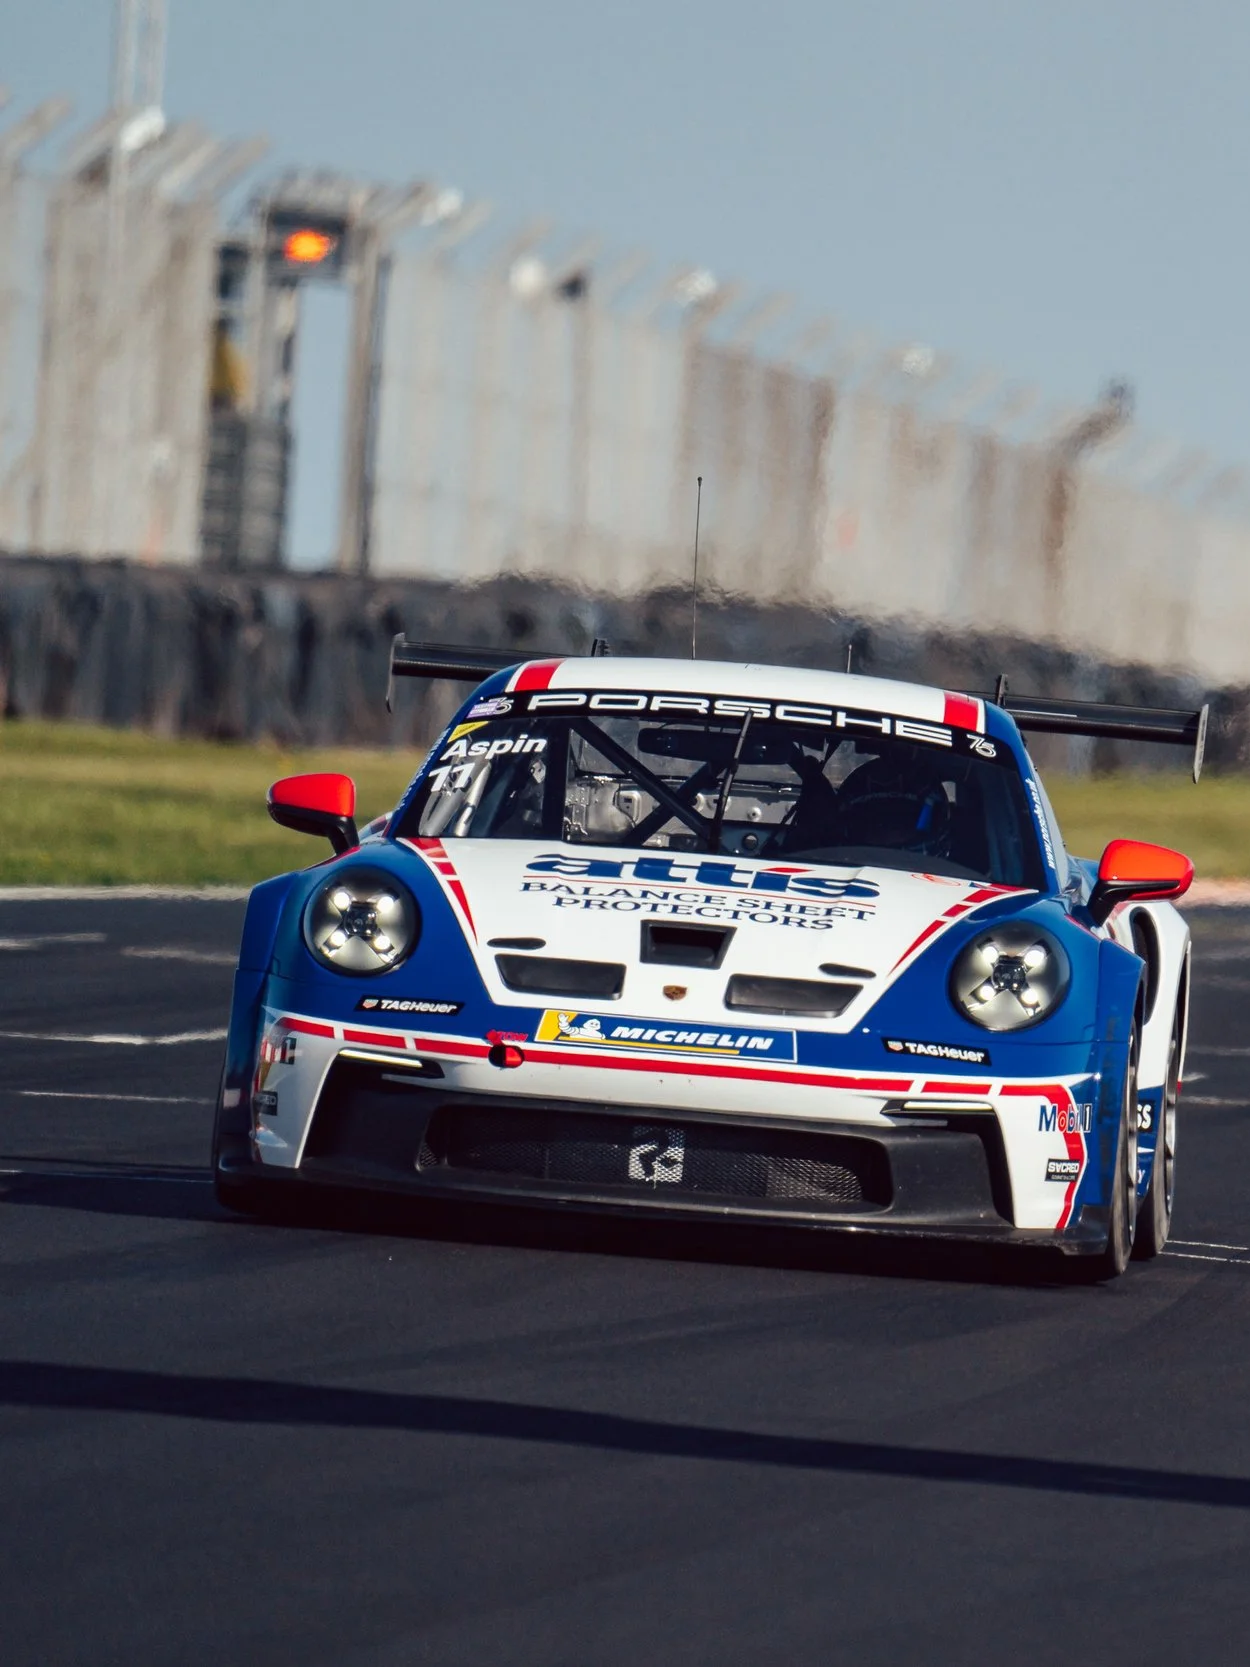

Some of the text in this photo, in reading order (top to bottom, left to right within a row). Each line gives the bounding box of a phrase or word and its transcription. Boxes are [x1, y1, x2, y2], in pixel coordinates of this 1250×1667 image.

[527, 693, 952, 747] PORSCHE
[440, 734, 547, 760] Aspin
[428, 762, 475, 792] 11
[525, 854, 880, 898] attis
[520, 881, 876, 921] BALANCE SHEET
[553, 895, 834, 930] PROTECTORS
[610, 1026, 774, 1050] MICHELIN
